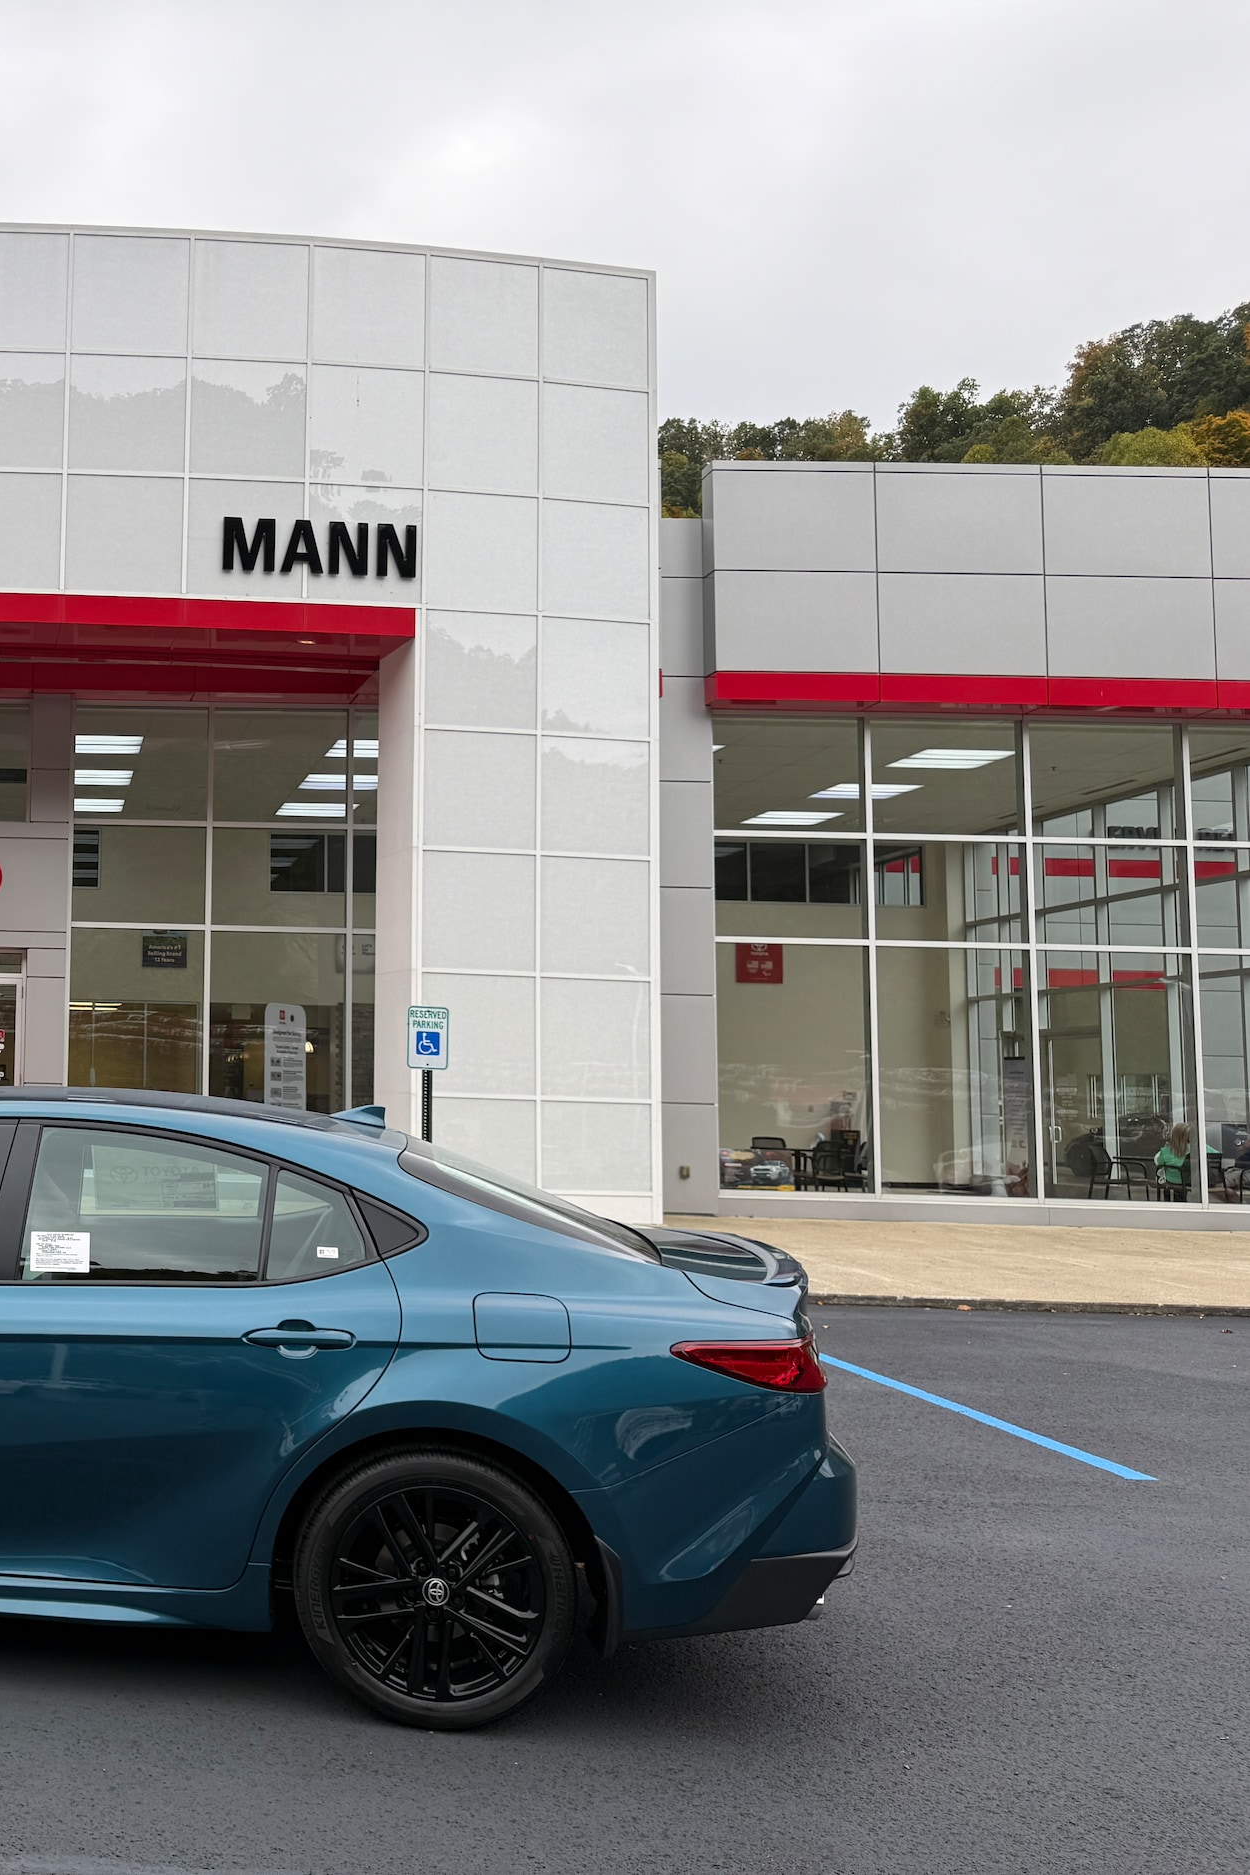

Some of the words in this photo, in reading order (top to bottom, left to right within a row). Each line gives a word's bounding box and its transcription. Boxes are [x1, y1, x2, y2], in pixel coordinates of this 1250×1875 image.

[222, 516, 417, 578] MANN
[410, 1010, 446, 1019] RESERVED
[413, 1020, 443, 1029] PARKING
